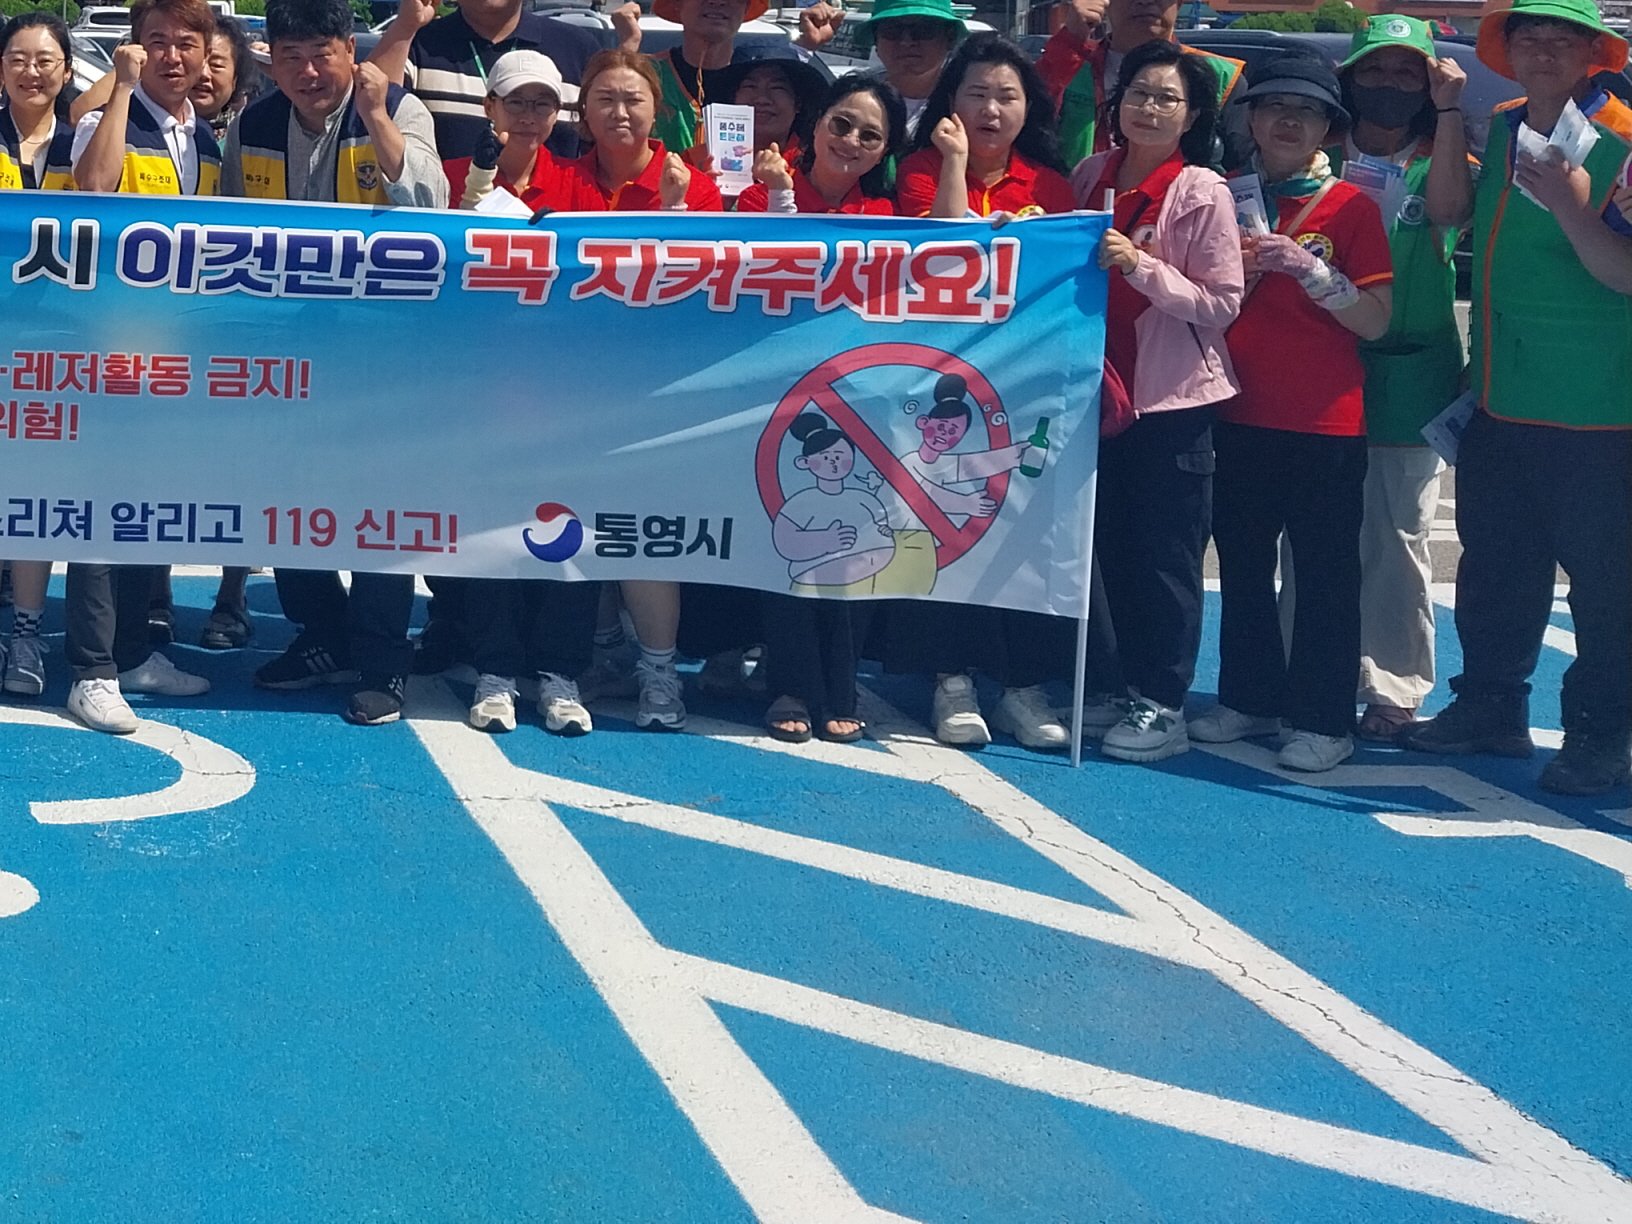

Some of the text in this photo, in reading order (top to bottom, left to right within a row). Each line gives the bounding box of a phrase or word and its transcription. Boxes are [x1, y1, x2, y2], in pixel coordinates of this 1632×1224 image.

[14, 216, 100, 290] 시
[119, 219, 446, 301] 이것만은
[462, 229, 559, 305] 꼭
[570, 237, 1021, 324] 지켜주세요!
[206, 355, 311, 400] 금지!
[110, 501, 244, 545] 알리고
[262, 506, 337, 548] 119
[354, 508, 459, 555] 신고!
[594, 512, 734, 561] 통영시
